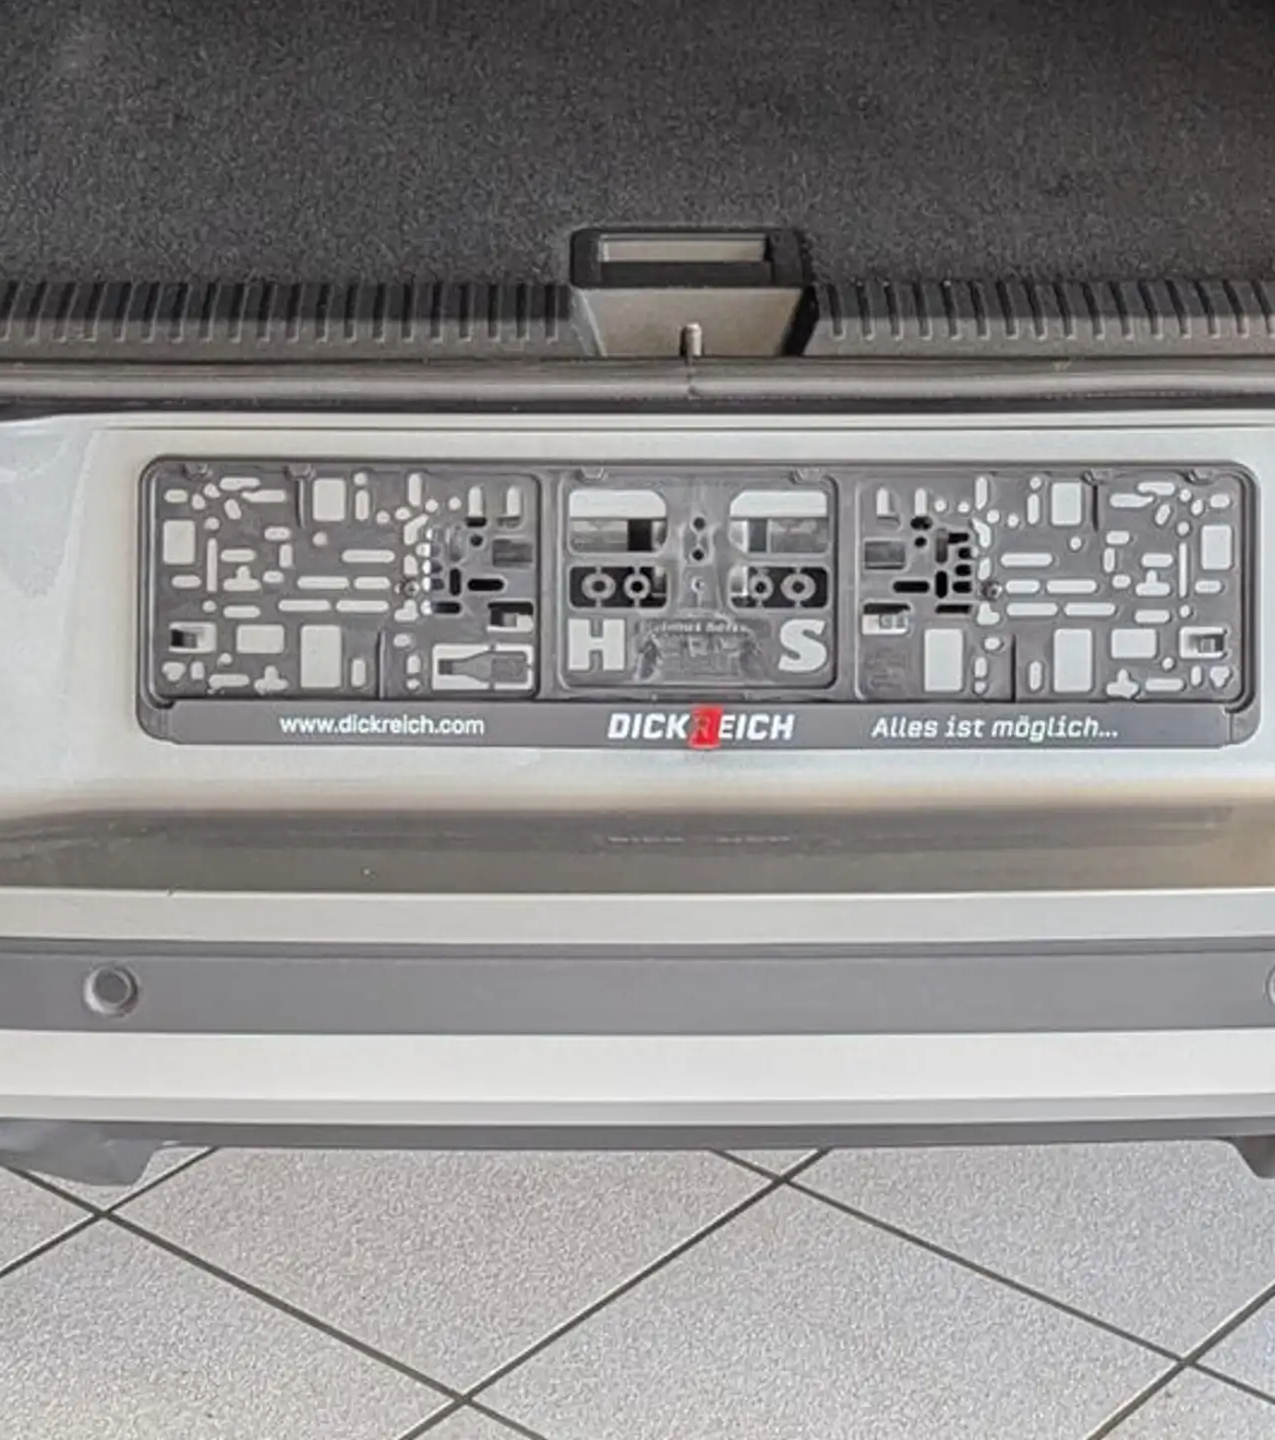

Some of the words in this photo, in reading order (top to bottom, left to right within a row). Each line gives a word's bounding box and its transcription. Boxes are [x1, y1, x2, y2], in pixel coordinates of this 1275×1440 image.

[279, 714, 485, 735] www.dickreich.com
[871, 716, 938, 738] Alles
[944, 716, 984, 738] ist
[991, 716, 1118, 743] möglich...
